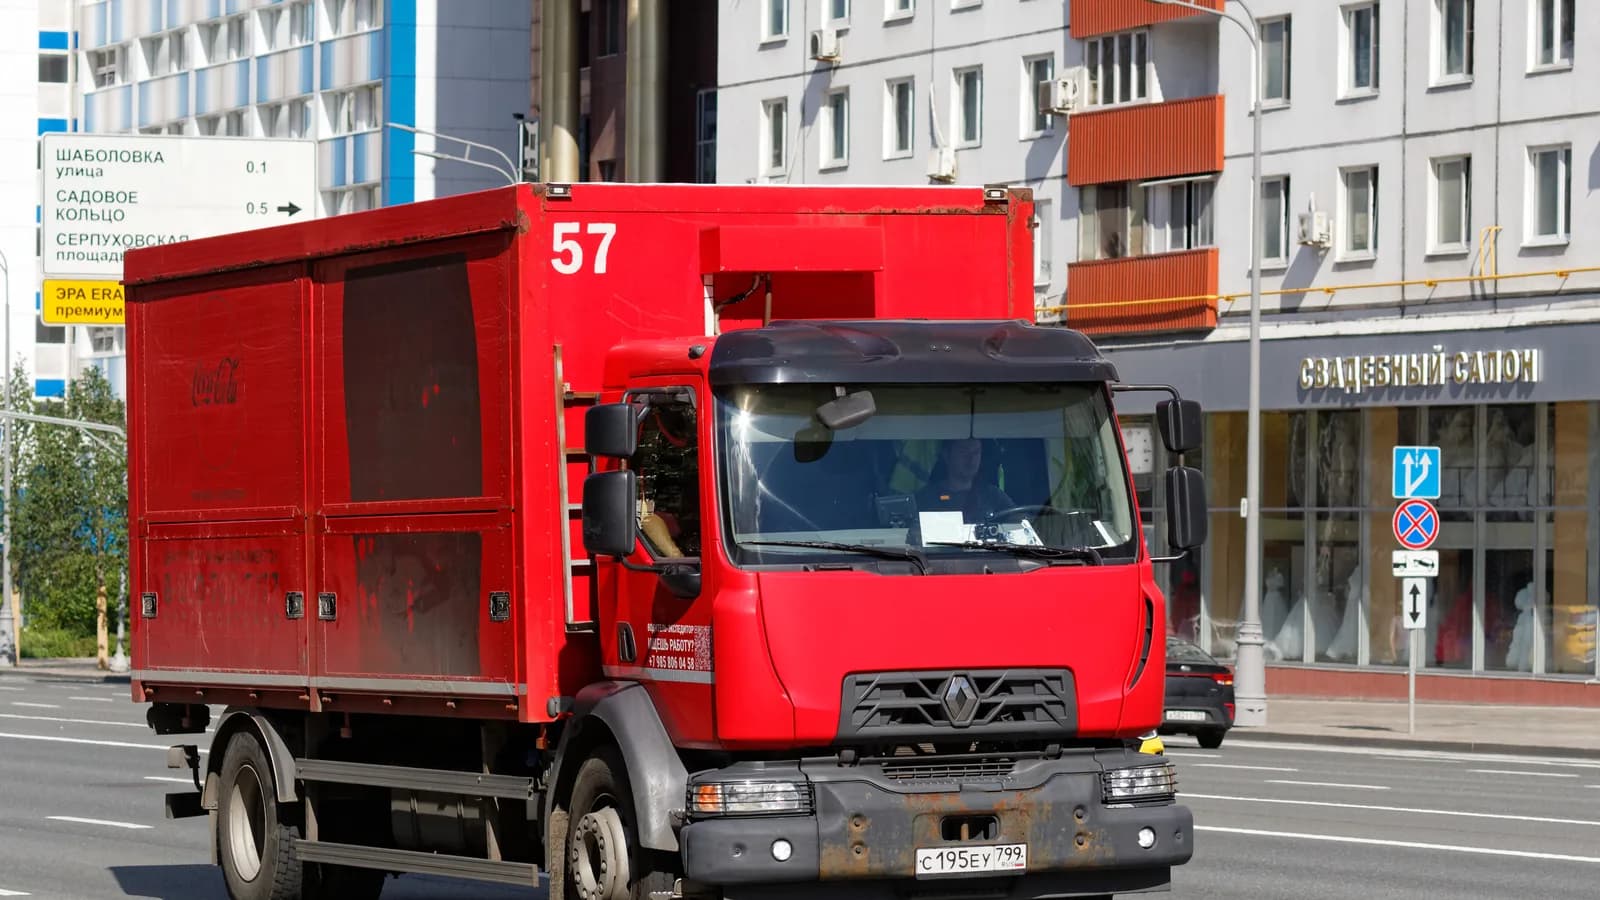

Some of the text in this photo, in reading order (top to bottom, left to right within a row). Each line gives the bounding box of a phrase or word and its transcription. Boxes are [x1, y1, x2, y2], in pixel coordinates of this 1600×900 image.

[56, 149, 164, 164] ШАБОЛОВКА
[56, 166, 104, 178] улица
[246, 161, 267, 173] 0.1
[56, 190, 138, 204] САДОВОЕ
[56, 208, 125, 222] КОЛЬЦО
[246, 203, 268, 215] 0.5
[551, 222, 617, 274] 57
[56, 288, 122, 300] ЭРА ERA
[1301, 344, 1539, 393] СВАДЕБНЫЙ САЛОН
[670, 639, 694, 652] РАБОТУ?
[996, 847, 1021, 861] 799
